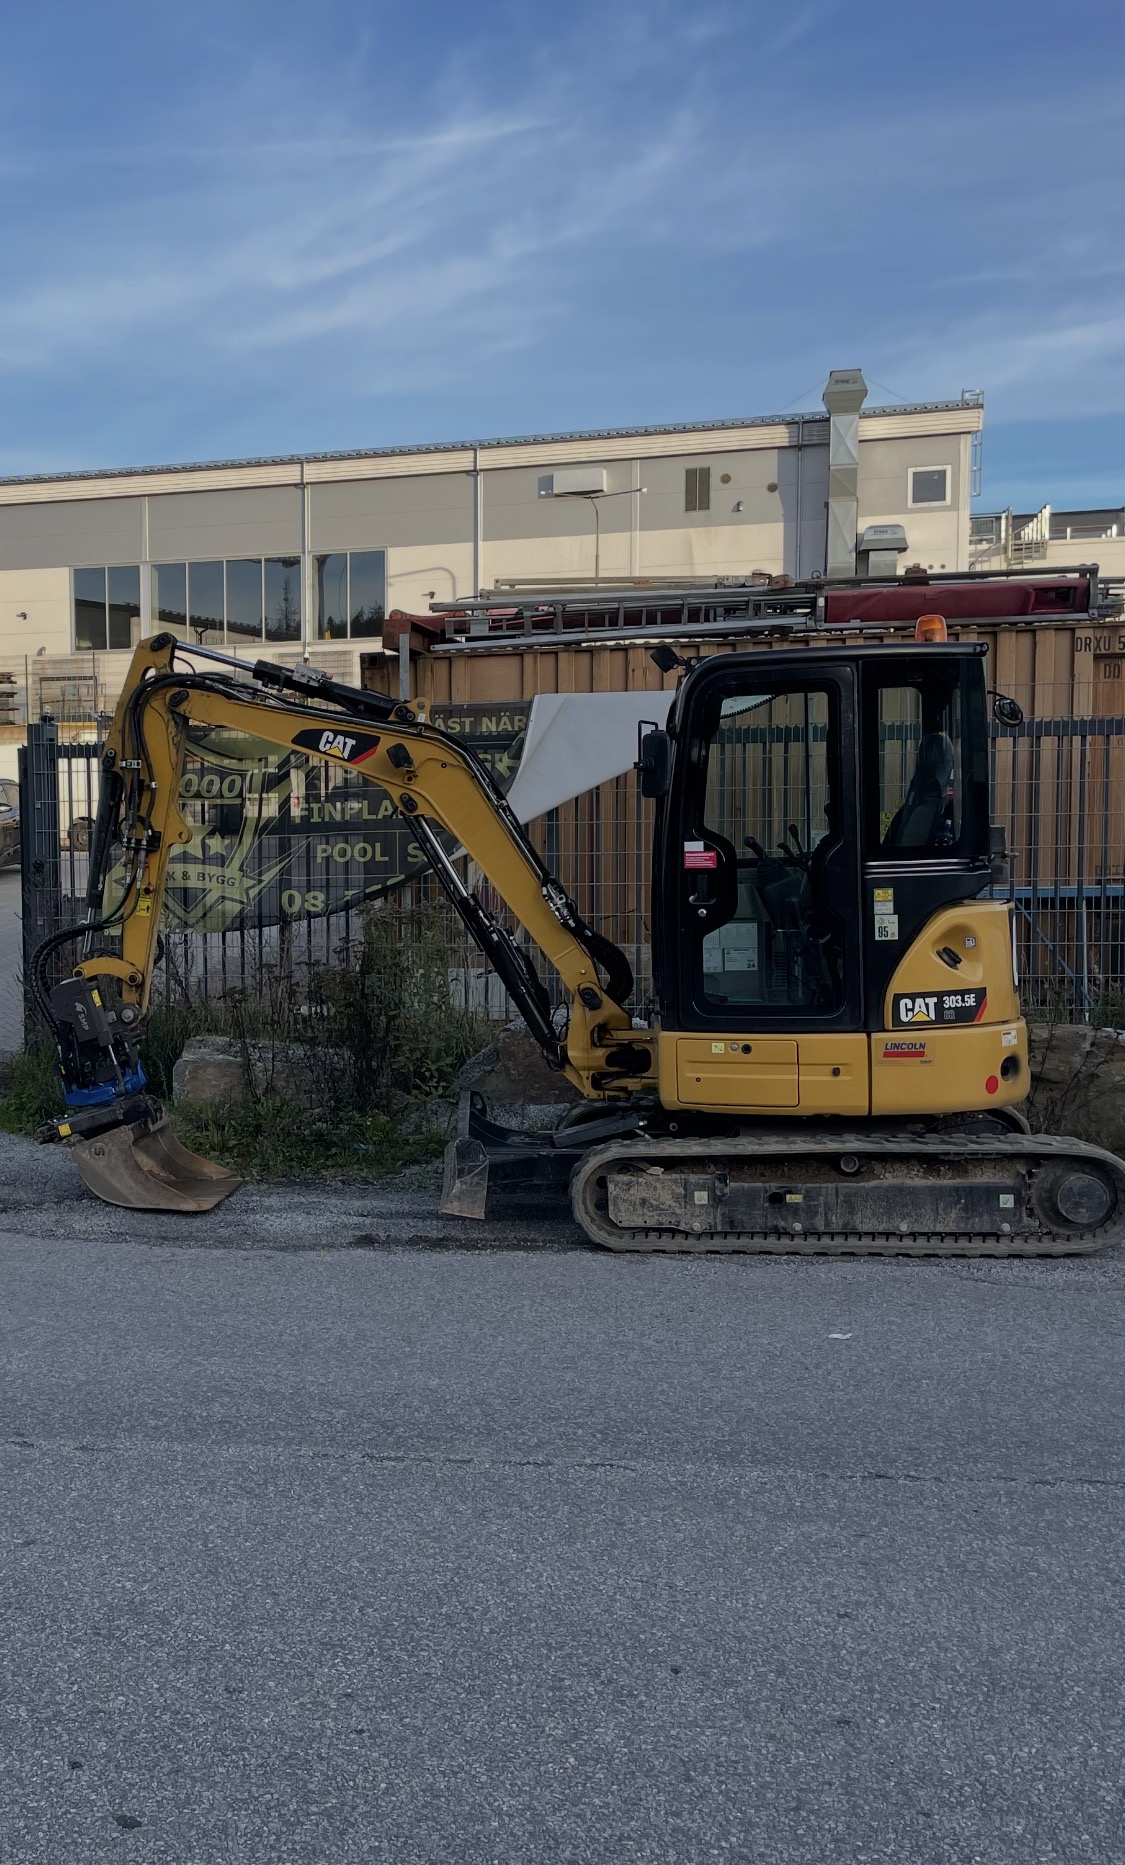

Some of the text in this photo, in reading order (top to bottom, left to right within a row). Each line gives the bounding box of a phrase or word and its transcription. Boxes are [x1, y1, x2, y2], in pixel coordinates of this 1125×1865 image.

[1075, 635, 1111, 652] DRXU
[433, 714, 474, 733] ÄST
[319, 730, 356, 760] CAT
[180, 773, 242, 798] 000
[294, 799, 402, 823] FINPLA
[316, 842, 389, 863] POOL
[181, 870, 191, 881] &
[197, 871, 236, 887] BYGG
[281, 889, 325, 913] 08
[877, 925, 889, 938] 95
[899, 993, 977, 1023] CAT 303.5E
[78, 1013, 89, 1031] SMP
[884, 1042, 926, 1051] LINCOLN
